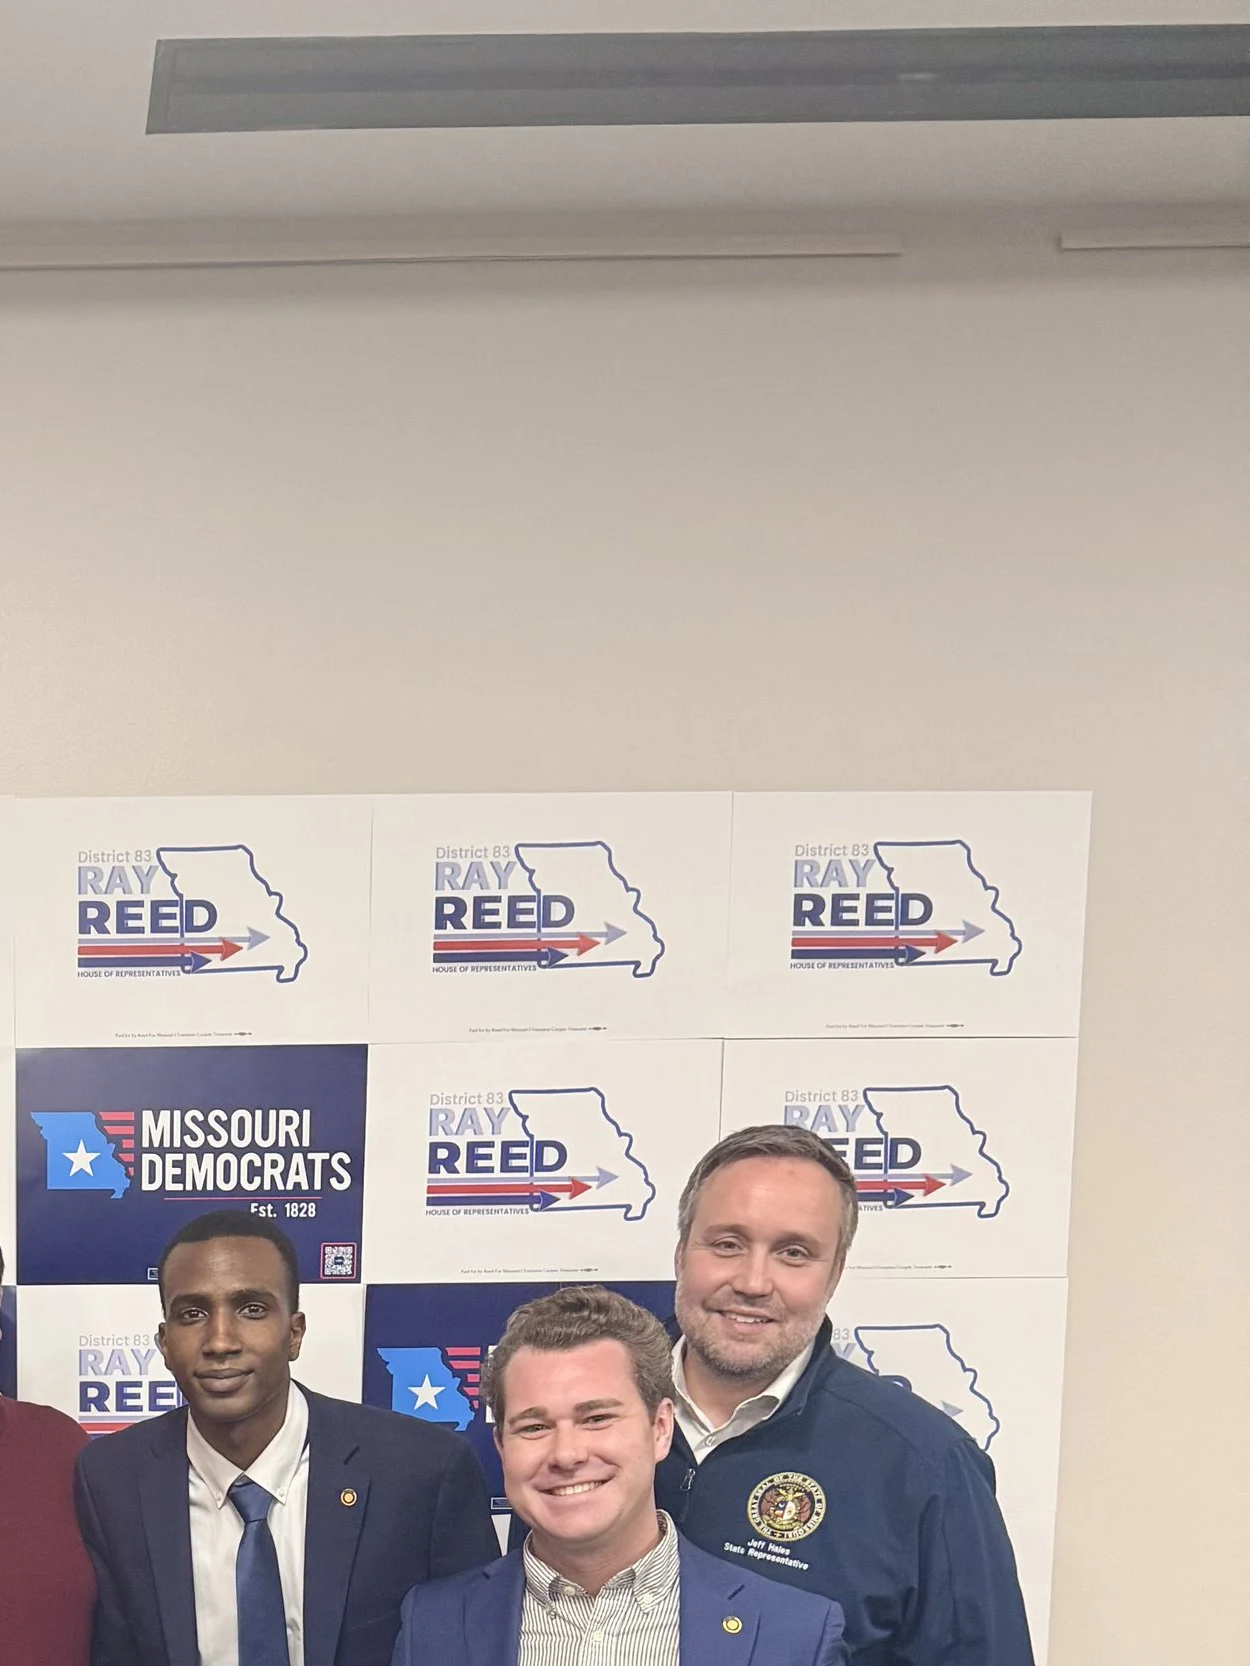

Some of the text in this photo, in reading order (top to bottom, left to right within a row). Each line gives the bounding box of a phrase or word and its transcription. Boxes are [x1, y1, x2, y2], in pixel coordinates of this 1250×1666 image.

[78, 850, 152, 863] District 83
[436, 846, 510, 858] District 83
[795, 844, 869, 856] District 83
[78, 865, 159, 895] RAY
[435, 861, 517, 891] RAY
[794, 859, 875, 887] RAY
[78, 899, 217, 934] REED
[435, 895, 575, 930] REED
[793, 893, 933, 926] REED
[430, 1093, 504, 1105] District 83
[785, 1090, 858, 1102] District 83
[142, 1109, 310, 1148] MISSOURI
[429, 1107, 510, 1136] RAY
[784, 1105, 865, 1132] RAY
[428, 1140, 567, 1174] REED
[141, 1152, 352, 1191] DEMOCRATS
[250, 1203, 316, 1217] Est. 1828
[79, 1334, 150, 1346] District 83
[834, 1329, 849, 1340] 83
[79, 1349, 156, 1375] RAY
[79, 1381, 189, 1412] REE
[724, 1542, 808, 1570] State Representative
[747, 1539, 765, 1549] Jeff
